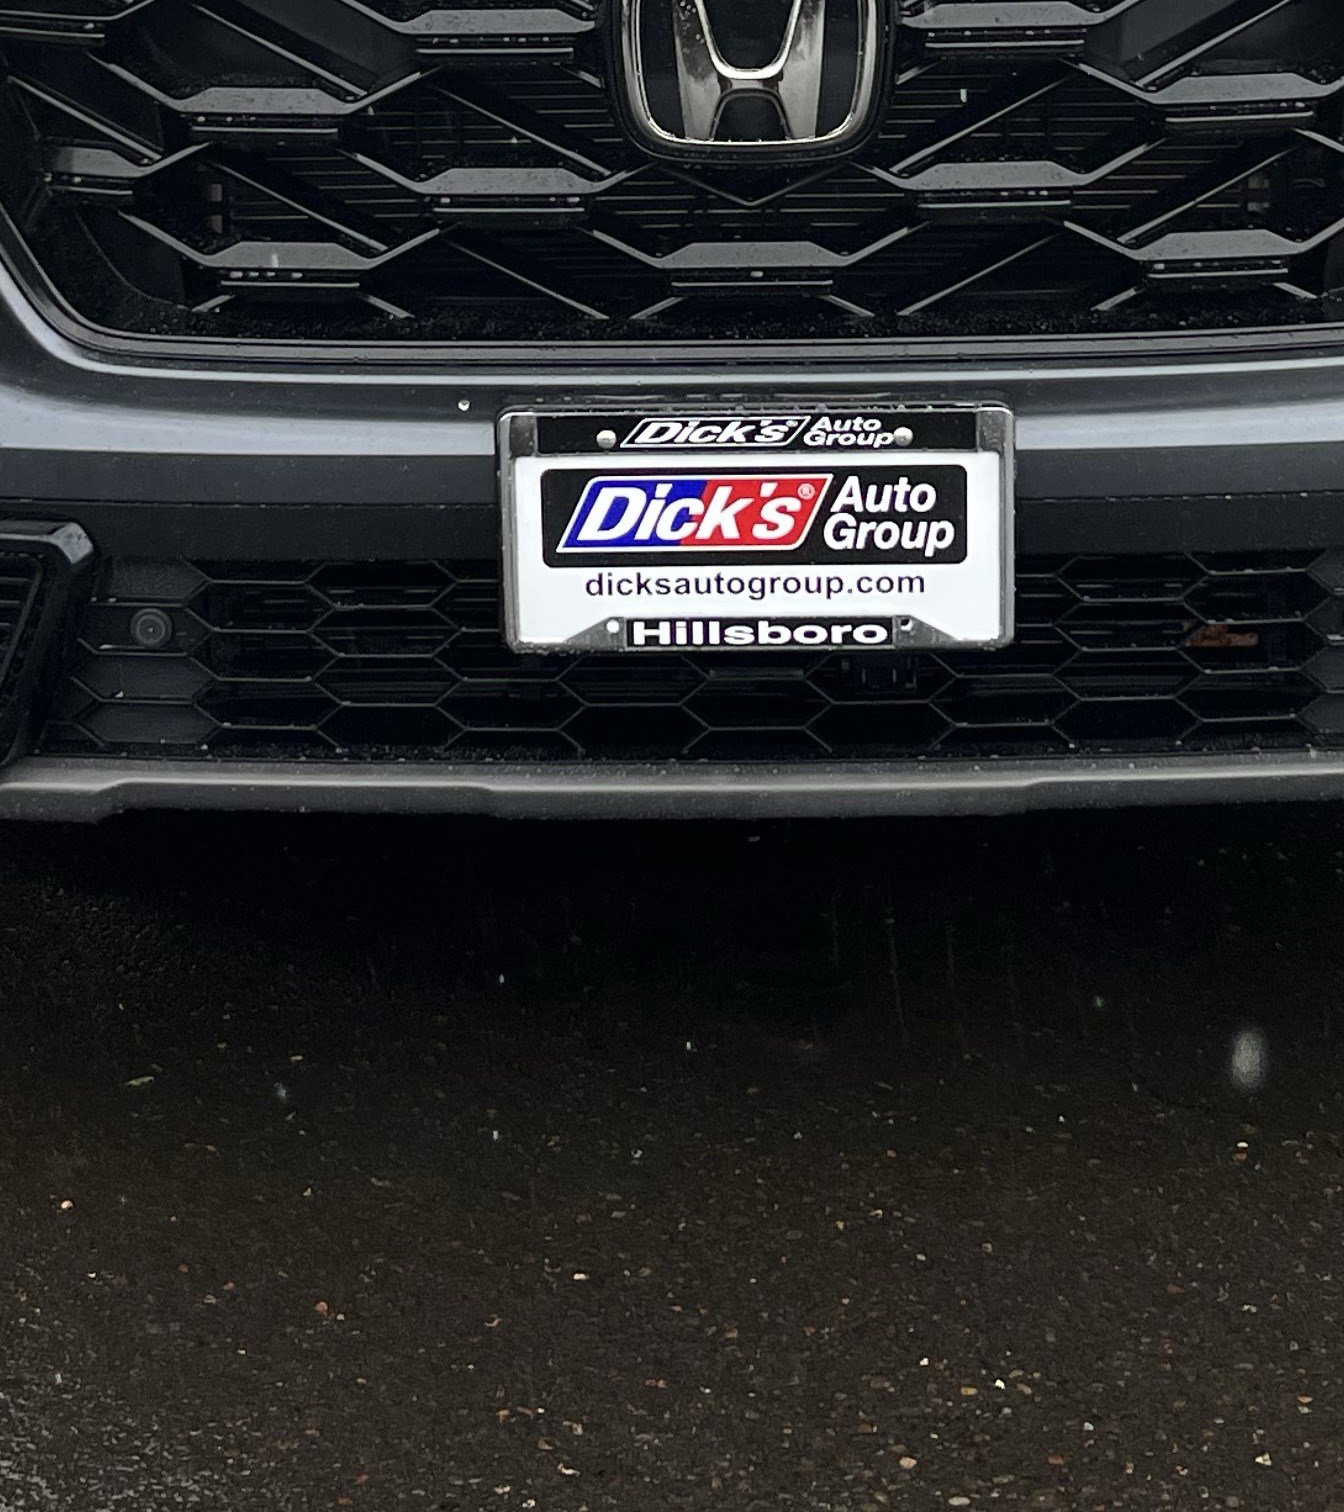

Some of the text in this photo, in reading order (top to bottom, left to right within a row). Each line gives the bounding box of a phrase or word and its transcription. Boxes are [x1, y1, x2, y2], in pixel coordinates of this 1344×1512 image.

[634, 416, 882, 444] Dick's Auto
[803, 430, 895, 449] Group
[575, 475, 938, 542] Dick's Auto
[822, 514, 956, 558] Group
[585, 571, 927, 601] dicksautogroup.com
[632, 620, 890, 647] Hillsboro
